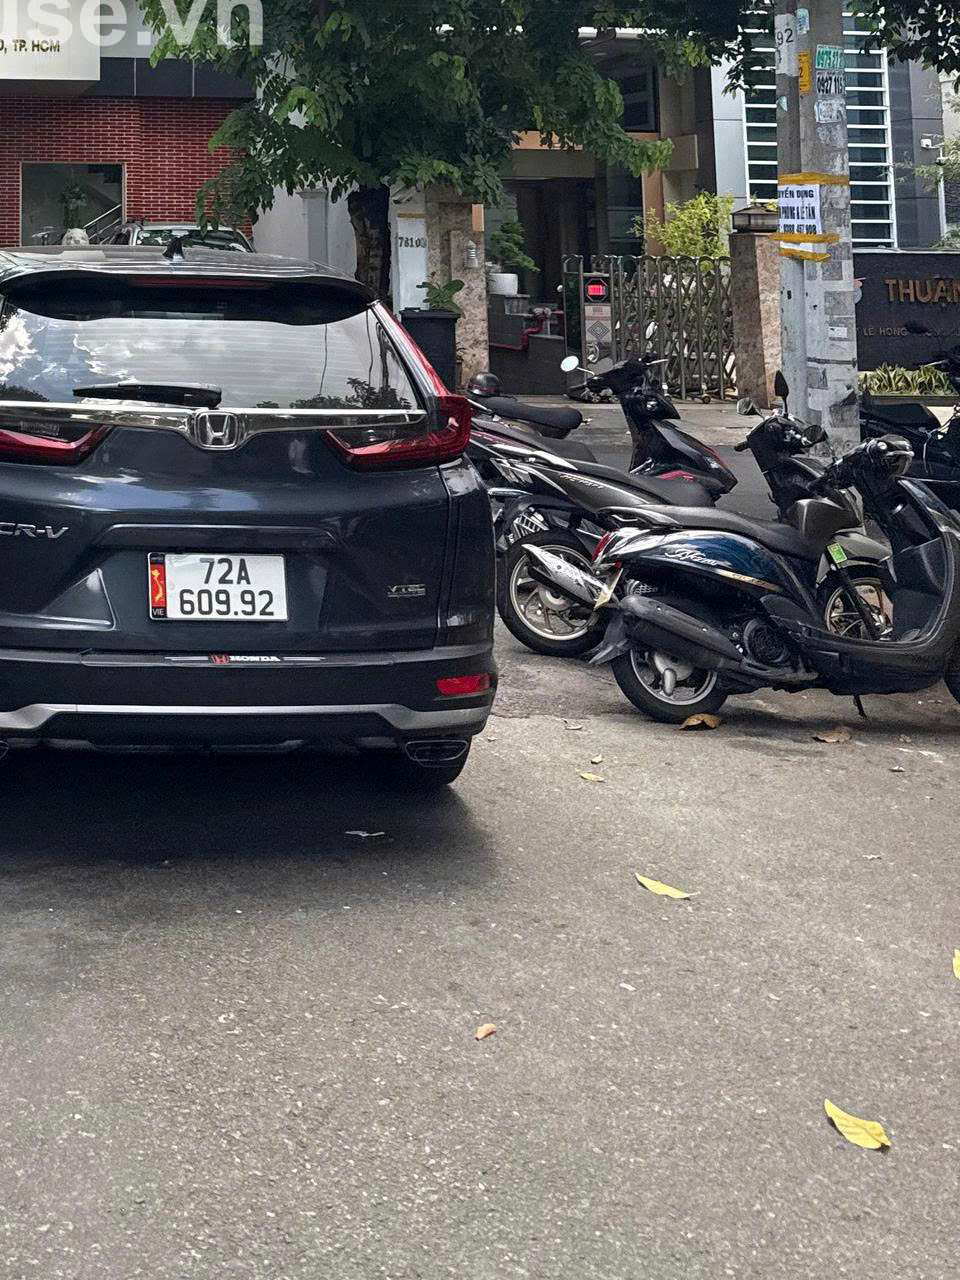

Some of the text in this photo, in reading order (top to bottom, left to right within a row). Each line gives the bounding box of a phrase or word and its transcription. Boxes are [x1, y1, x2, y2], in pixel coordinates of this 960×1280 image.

[13, 40, 28, 52] TP.
[31, 40, 60, 53] HCM
[199, 557, 251, 585] 72A
[152, 607, 165, 616] VIE
[179, 588, 275, 616] 609.92
